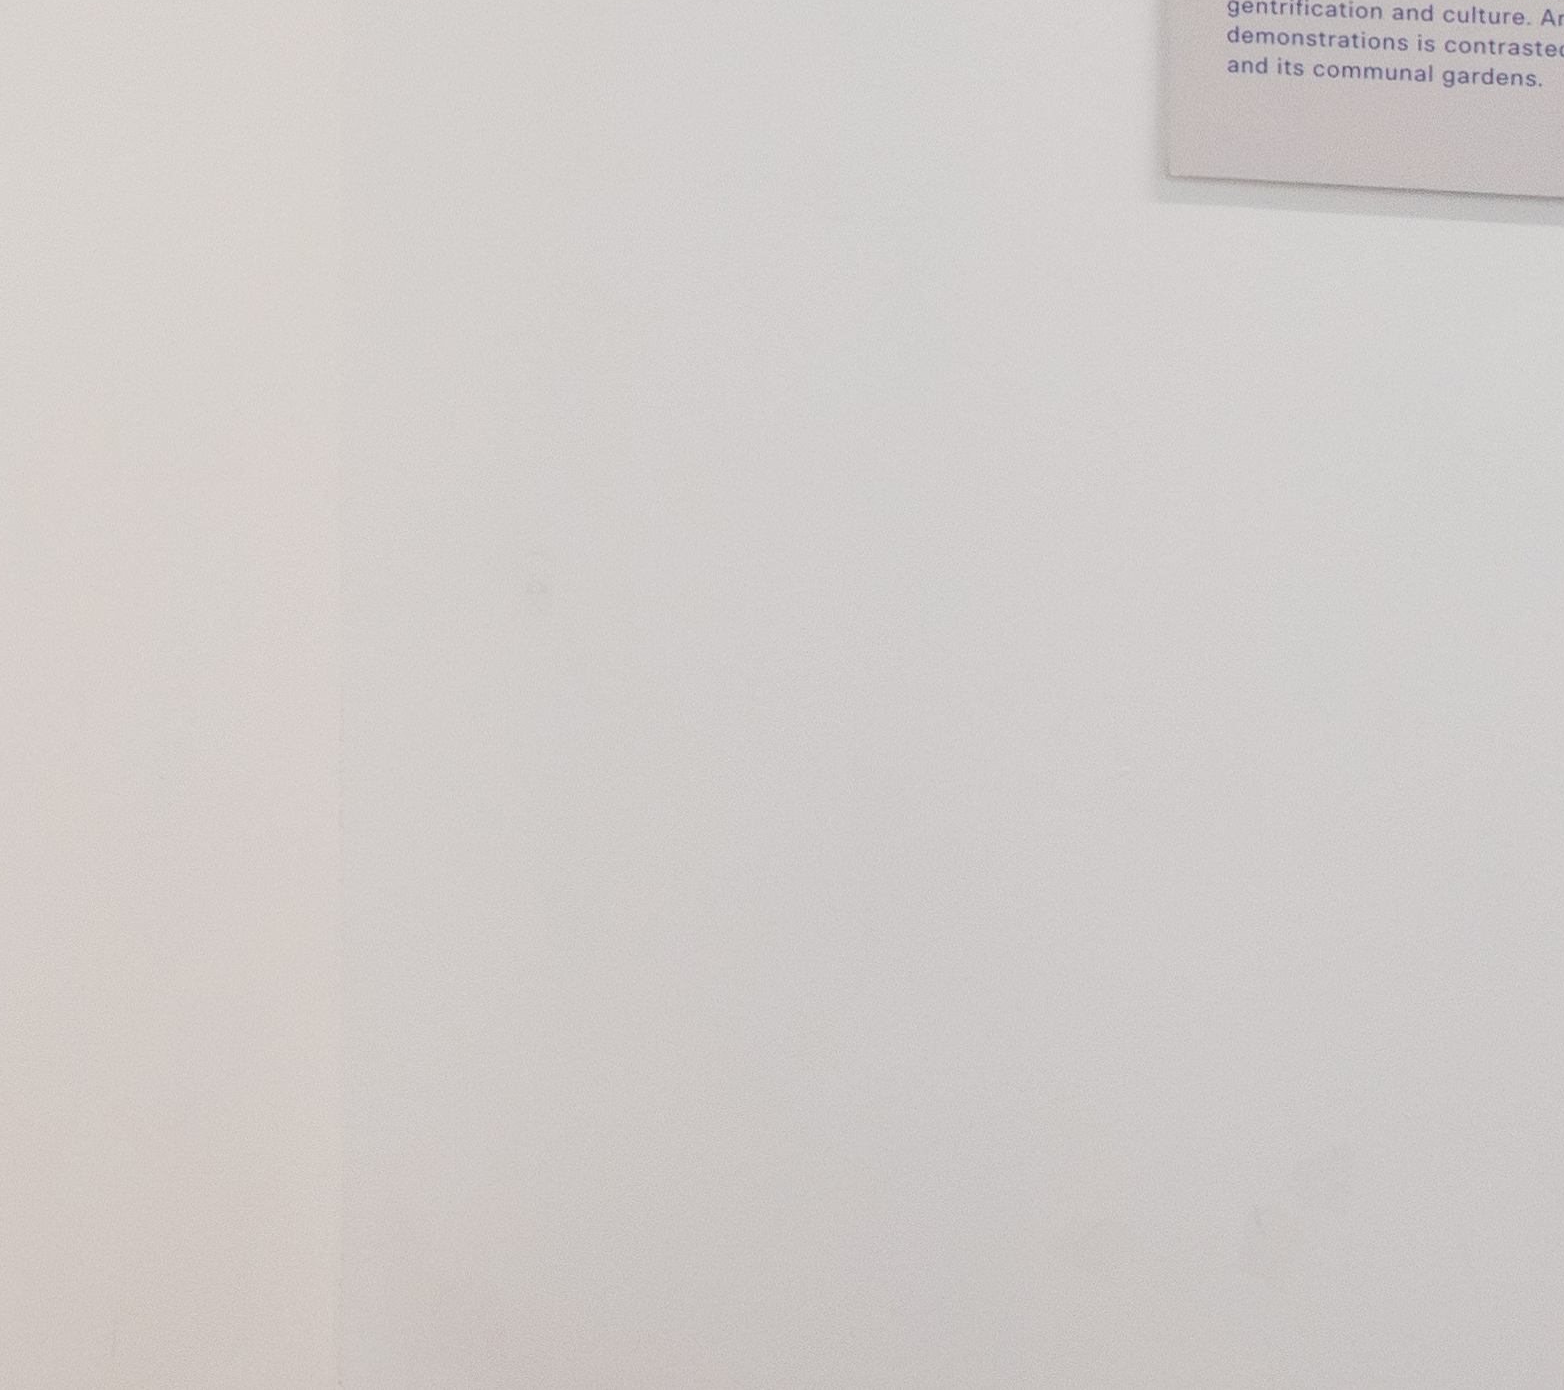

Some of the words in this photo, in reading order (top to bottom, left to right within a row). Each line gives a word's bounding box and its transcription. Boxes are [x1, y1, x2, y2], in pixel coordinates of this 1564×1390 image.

[1226, 56, 1270, 76] and
[1276, 57, 1306, 78] its
[1312, 63, 1435, 84] communal
[1441, 67, 1544, 89] gardens.
